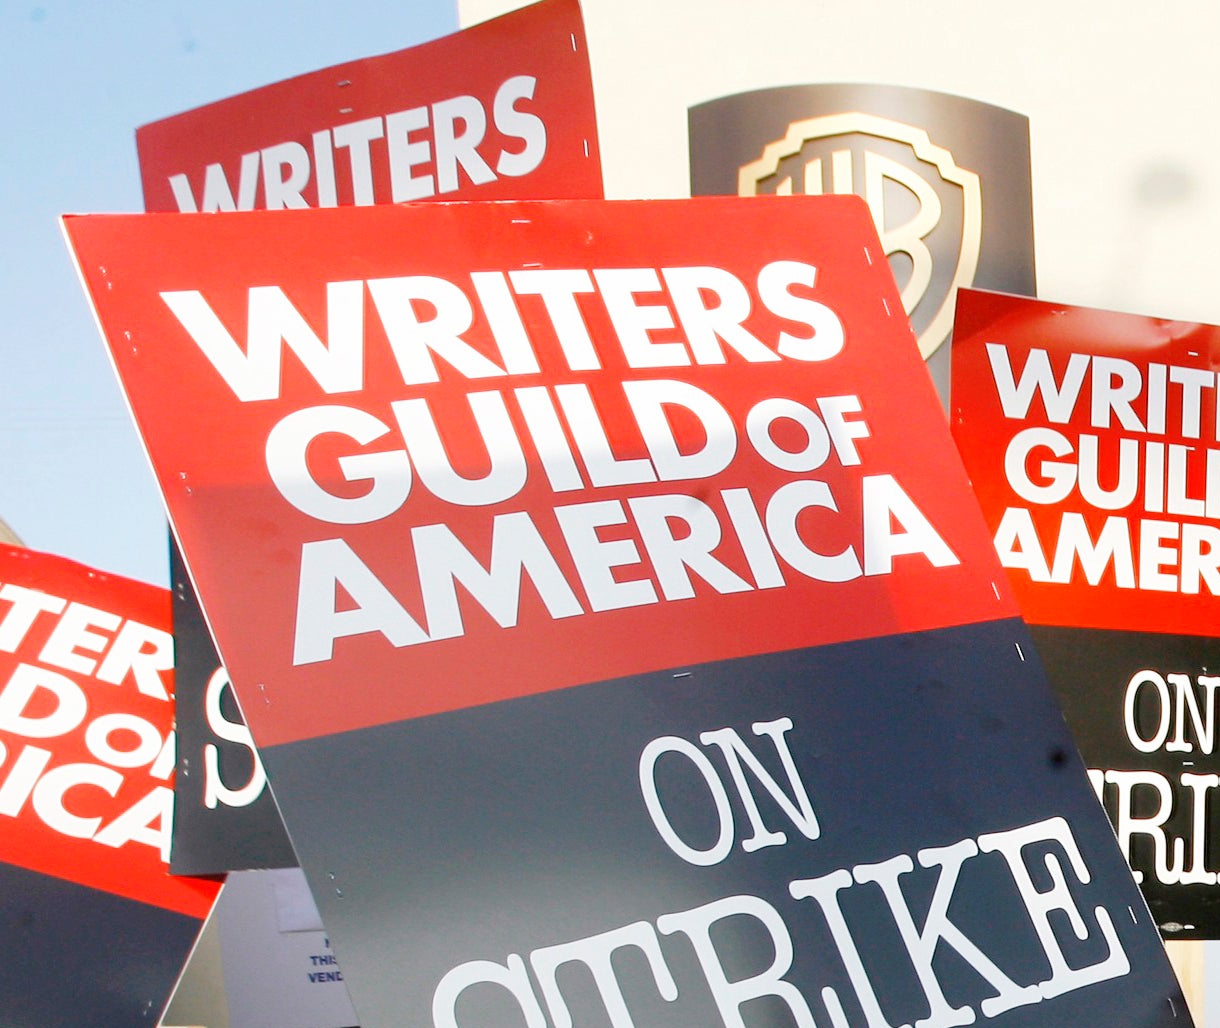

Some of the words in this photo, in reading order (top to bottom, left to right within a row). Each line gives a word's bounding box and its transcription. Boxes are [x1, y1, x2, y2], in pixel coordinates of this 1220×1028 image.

[168, 76, 548, 212] WRITERS
[159, 259, 847, 403] WRITERS
[265, 379, 738, 525] GUILD
[746, 395, 870, 474] OF
[293, 474, 961, 666] AMERICA
[0, 744, 174, 864] ICA
[639, 717, 821, 866] ON
